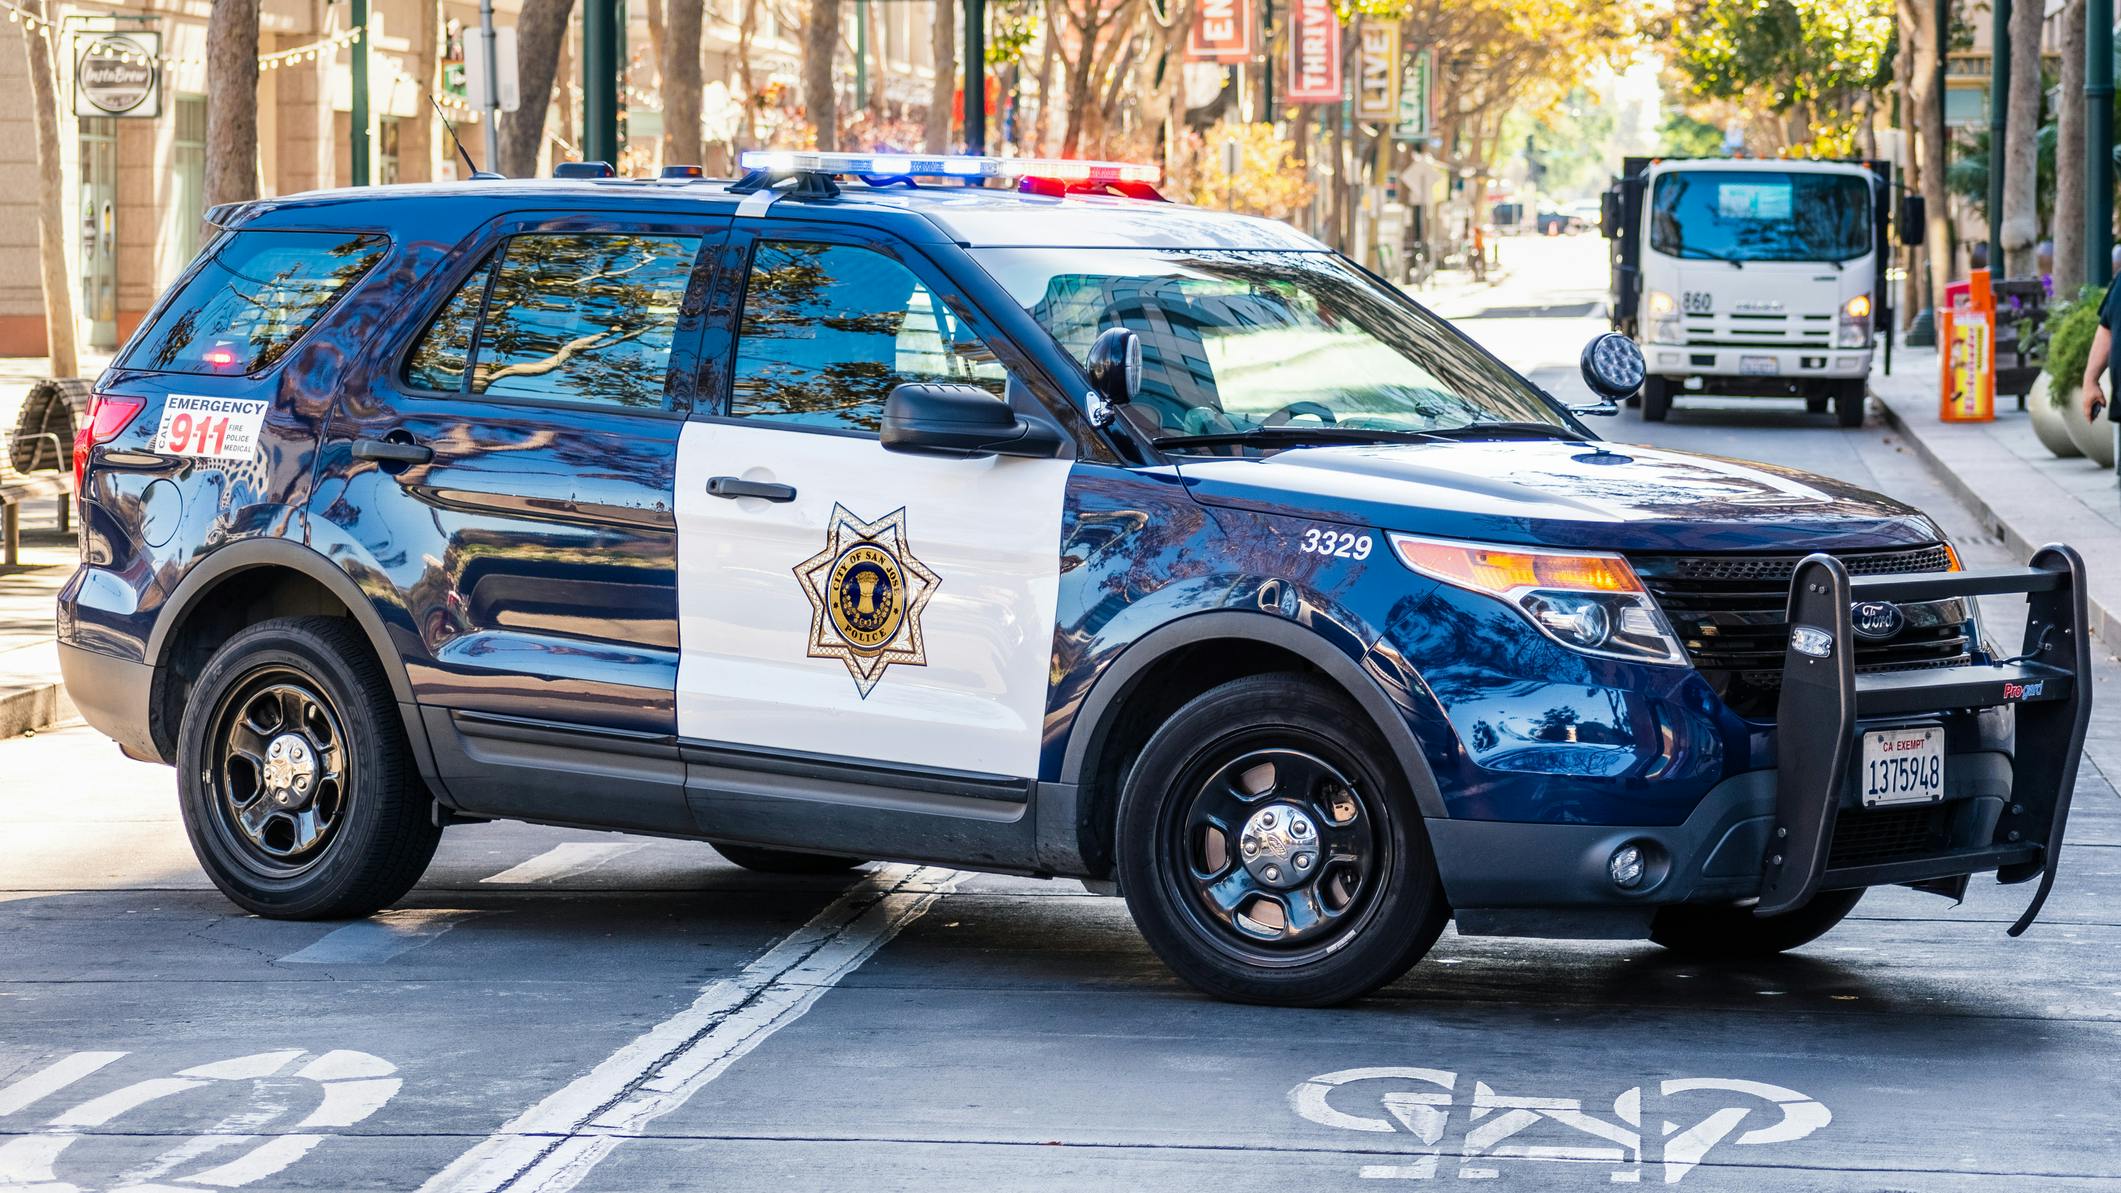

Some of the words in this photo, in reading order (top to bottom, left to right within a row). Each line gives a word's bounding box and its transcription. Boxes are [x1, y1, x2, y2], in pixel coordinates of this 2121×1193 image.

[1362, 30, 1390, 110] LIVE
[1682, 292, 1712, 311] 860
[168, 398, 265, 414] EMERGENCY
[159, 414, 172, 448] CALL
[228, 424, 244, 432] FIRE
[226, 434, 250, 442] POLICE
[224, 444, 252, 453] MEDICAL
[1301, 528, 1373, 560] 3329
[833, 562, 848, 591] CITY
[850, 552, 862, 563] OF
[866, 551, 886, 565] SAN
[1862, 605, 1894, 629] Ford
[844, 623, 887, 642] POLICE
[1883, 742, 1893, 752] CA
[1897, 739, 1925, 751] EXEMPT
[1868, 755, 1939, 795] 1375948
